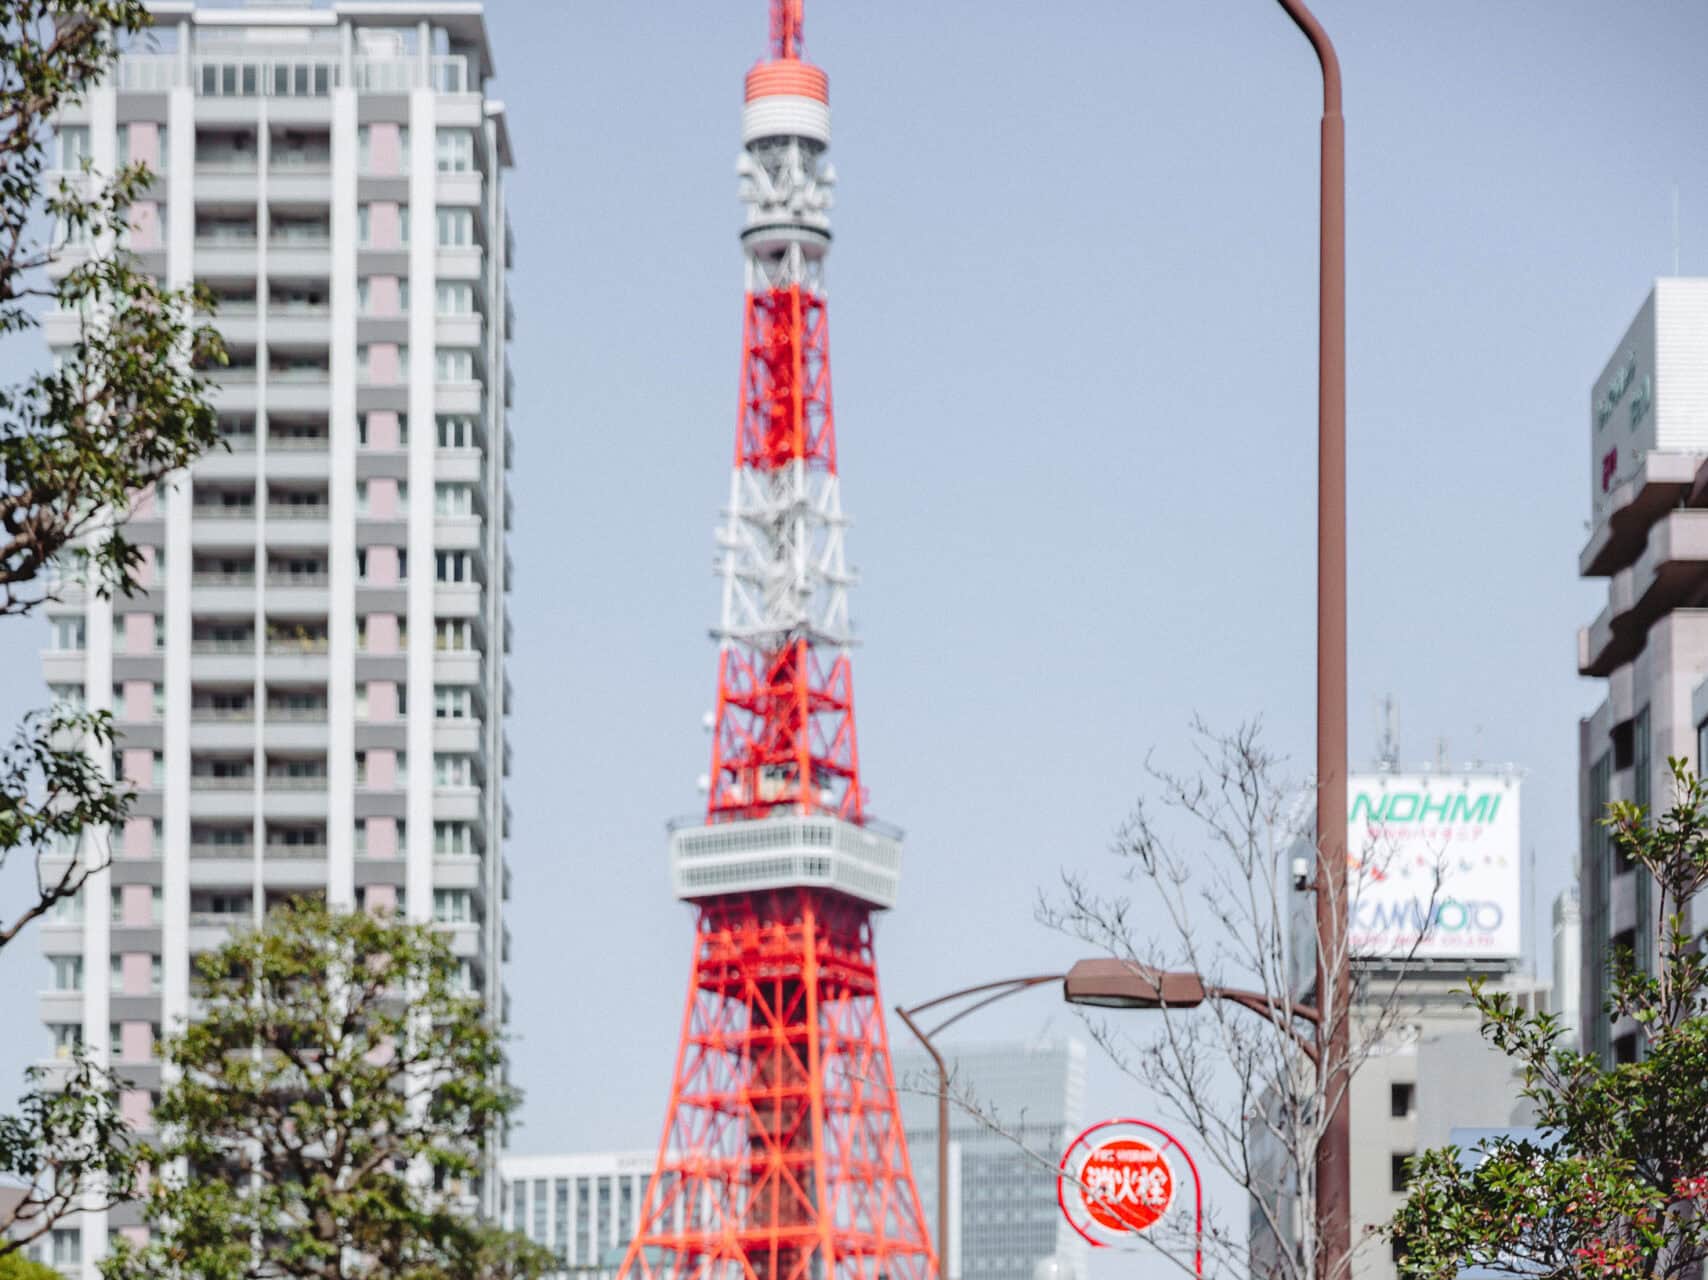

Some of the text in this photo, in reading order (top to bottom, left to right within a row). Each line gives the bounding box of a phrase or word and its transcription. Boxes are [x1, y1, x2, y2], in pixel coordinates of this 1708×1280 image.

[1349, 792, 1502, 824] NOHMI
[1086, 1165, 1169, 1206] 消火栓
